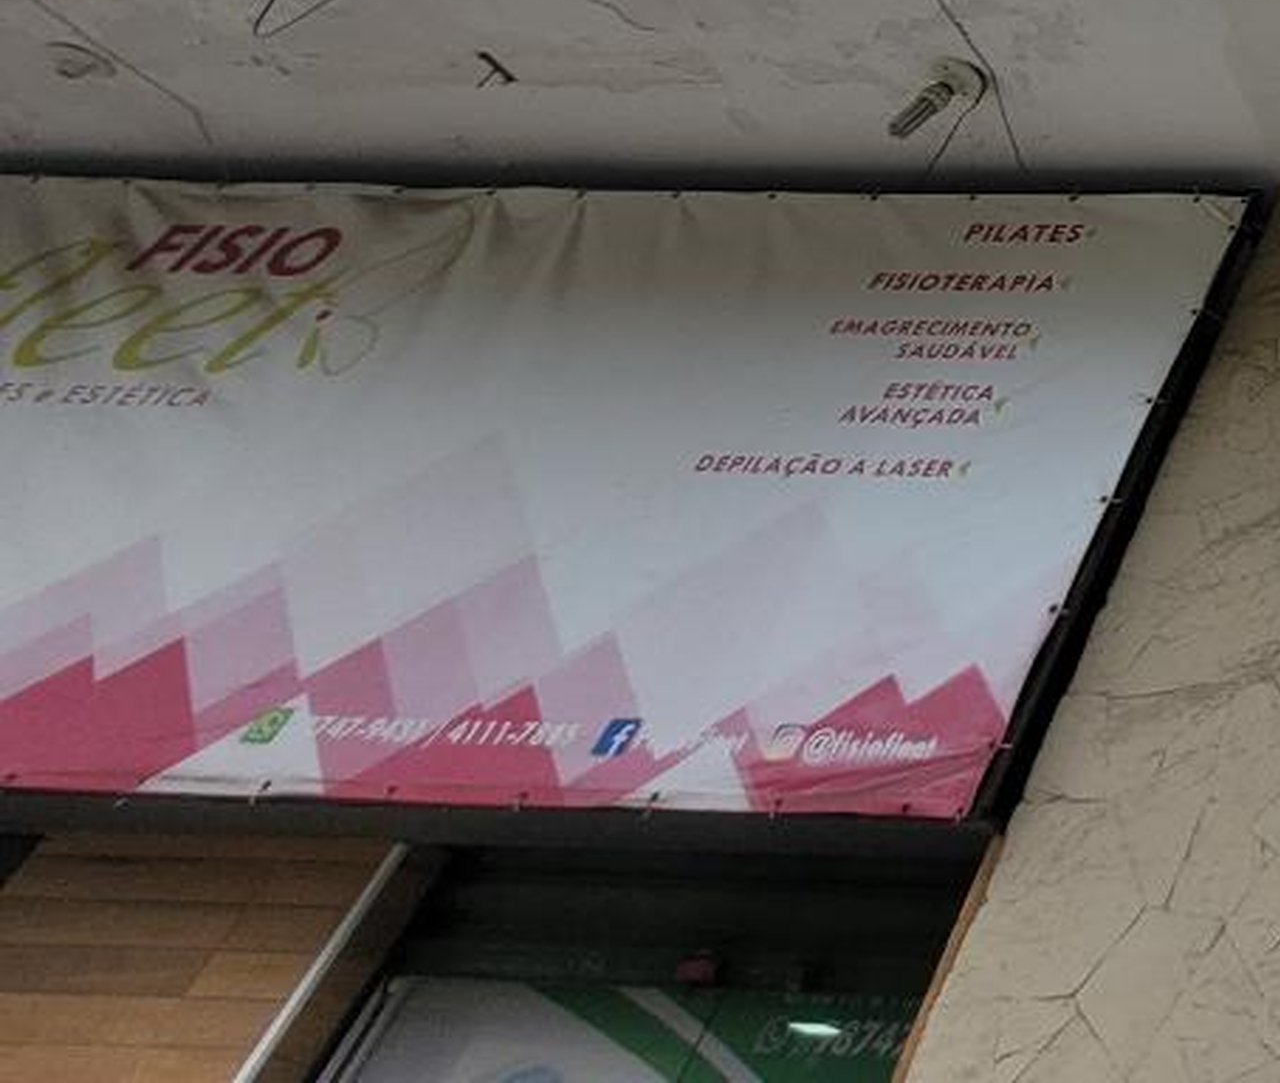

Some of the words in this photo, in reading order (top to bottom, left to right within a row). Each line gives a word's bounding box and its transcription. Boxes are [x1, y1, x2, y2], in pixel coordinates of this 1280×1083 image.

[964, 224, 1084, 244] PILATES
[126, 224, 342, 277] FISIO
[868, 272, 1055, 293] FISIOTERAPIA
[829, 319, 1032, 337] EMAGRECIMENTO
[895, 341, 1018, 360] SAUDÁVEL
[62, 381, 210, 408] ESTÉTICA
[883, 380, 994, 401] ESTÉTICA
[839, 405, 981, 429] AVANÇADA
[695, 453, 843, 477] DEPILAÇÃO
[848, 459, 865, 475] A
[874, 460, 953, 478] LASER
